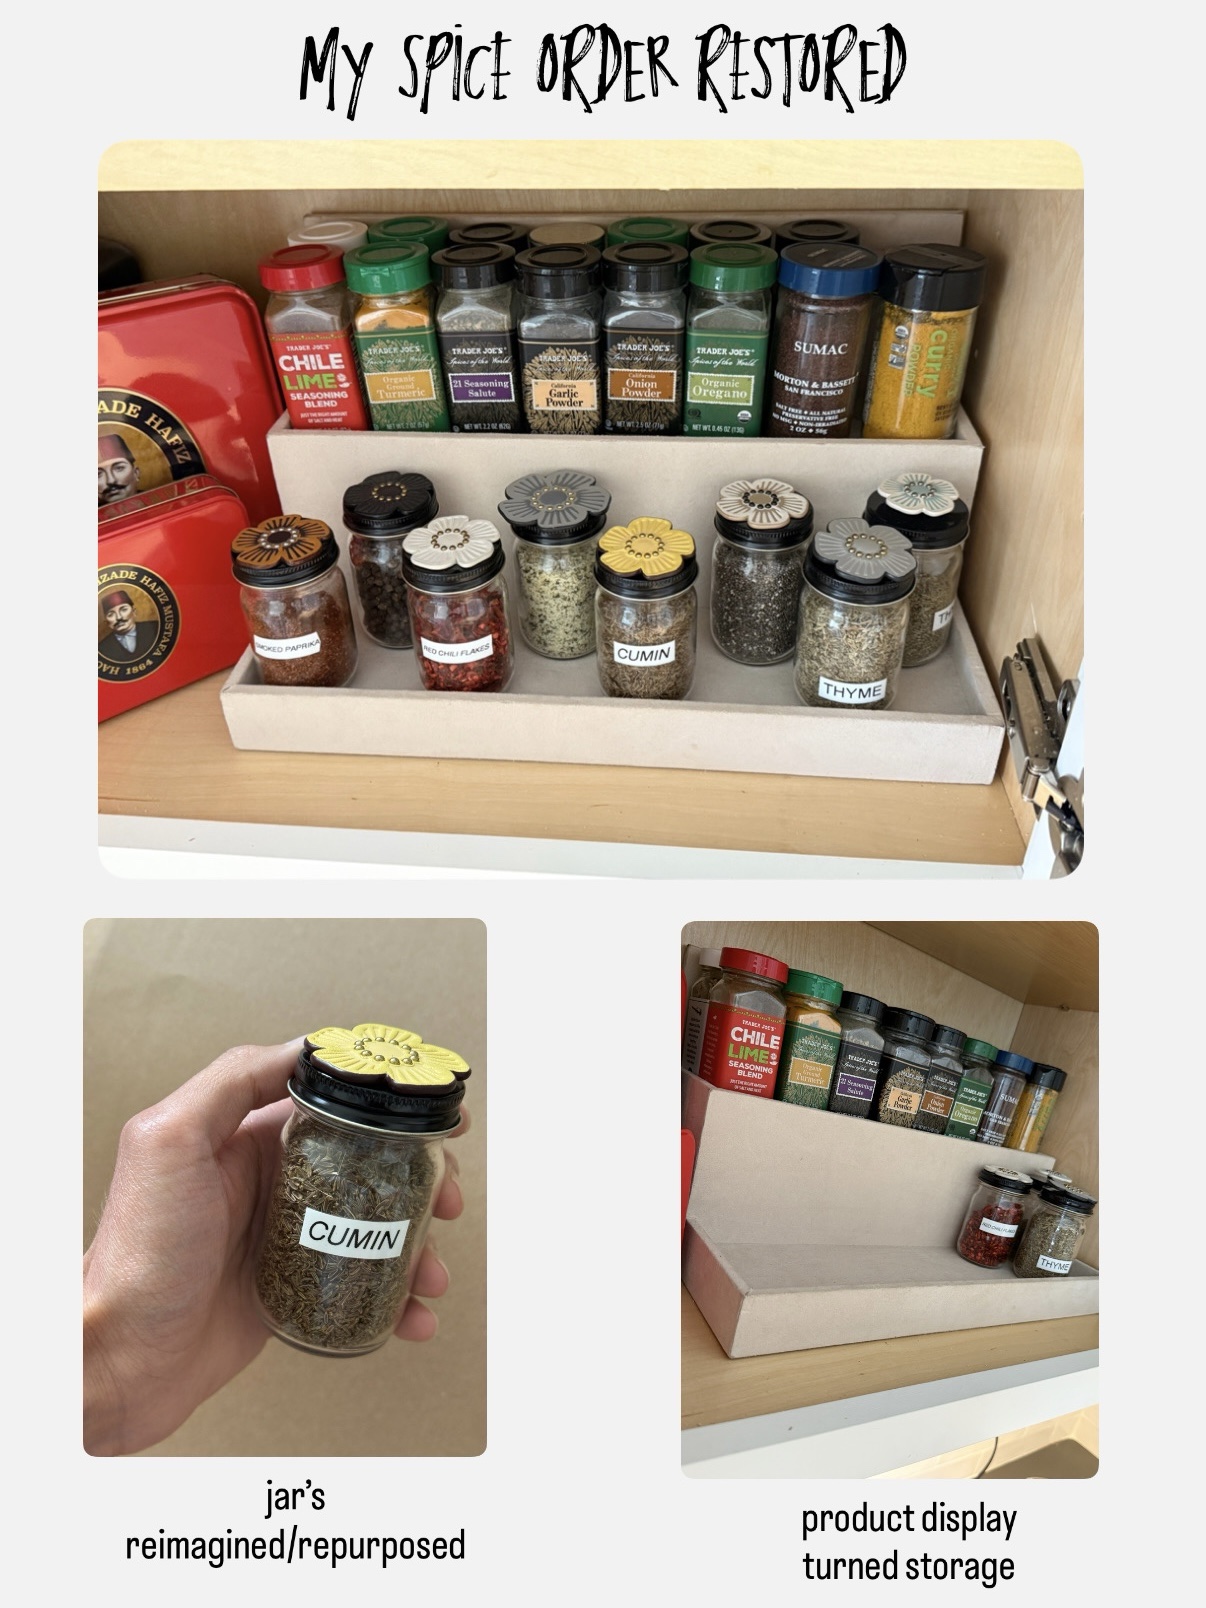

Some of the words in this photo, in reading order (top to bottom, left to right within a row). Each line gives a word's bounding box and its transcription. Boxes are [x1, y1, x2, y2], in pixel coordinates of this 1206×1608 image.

[696, 347, 727, 355] TRADER
[794, 341, 848, 355] SUMAC
[279, 353, 345, 371] CHILE
[916, 330, 948, 398] curry
[904, 344, 921, 397] POWDER
[283, 373, 337, 390] LIME
[453, 380, 462, 388] 21
[464, 379, 509, 388] Seasoning
[625, 378, 657, 388] Onion
[701, 378, 739, 388] Organic
[774, 370, 809, 388] MORTON
[822, 376, 856, 389] BASSETT
[376, 388, 425, 399] Turmeric
[386, 383, 414, 391] Ground
[468, 389, 496, 397] Salute
[549, 389, 578, 398] Garlic
[622, 388, 662, 398] Powder
[692, 385, 747, 399] Oregano
[785, 385, 799, 393] SAN
[290, 391, 348, 400] SEASONING
[304, 400, 337, 408] BLEND
[545, 398, 583, 407] Powder
[775, 402, 787, 411] SALT
[782, 411, 823, 421] PRESERVATIVE
[144, 413, 192, 464] HAFIZ
[140, 575, 170, 604] HAFIZ
[152, 605, 174, 657] MUSTAFA
[255, 642, 283, 652] SMOKED
[285, 639, 320, 652] PAPRIKA
[424, 645, 437, 654] RED
[460, 643, 489, 656] FLAKES
[617, 647, 671, 662] CUMIN
[125, 659, 154, 675] 1864
[823, 682, 882, 699] THYME
[731, 1026, 780, 1050] CHILE
[728, 1043, 769, 1064] LIME
[729, 1060, 773, 1074] SEASONING
[737, 1070, 763, 1079] BLEND
[309, 1221, 401, 1250] CUMIN
[1041, 1258, 1070, 1270] THYME
